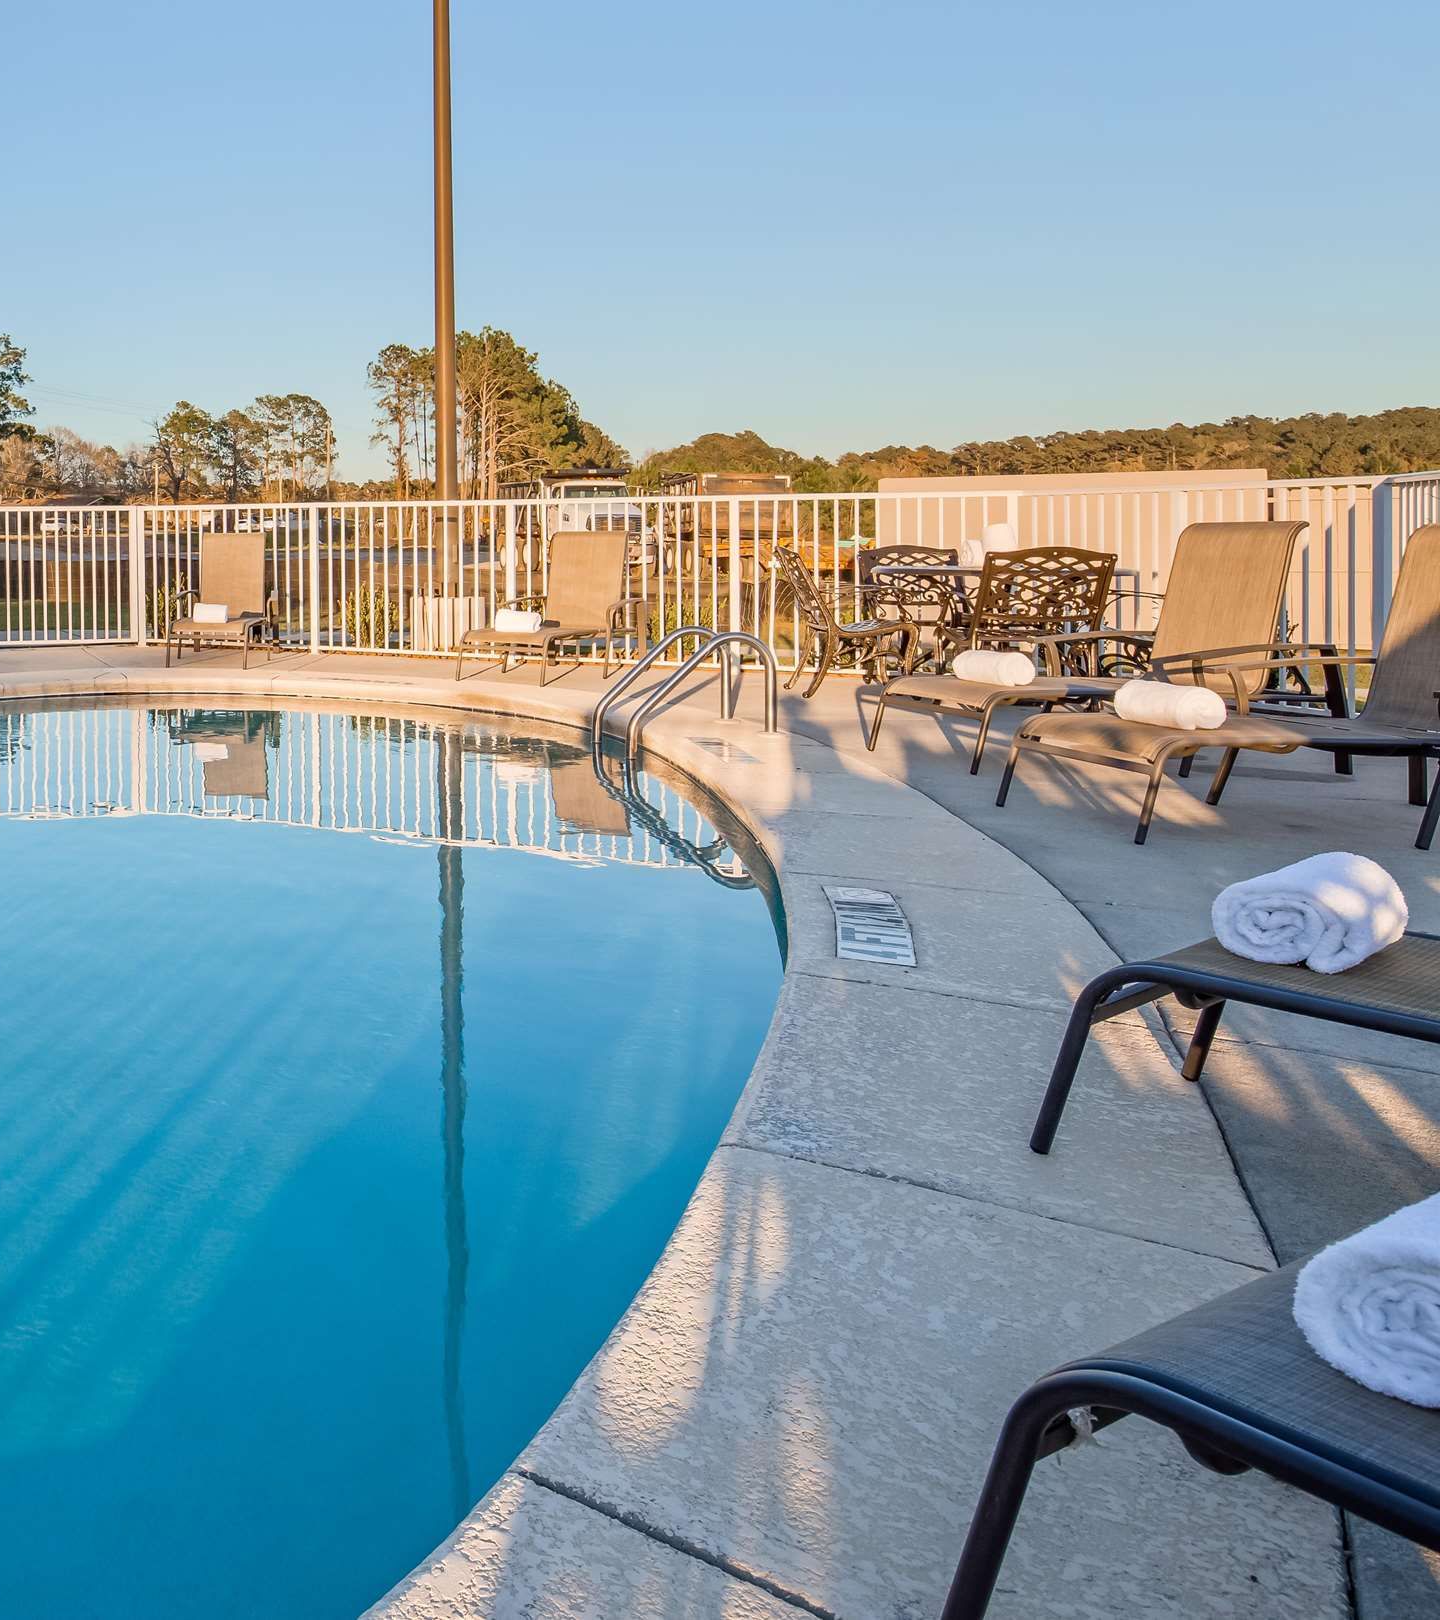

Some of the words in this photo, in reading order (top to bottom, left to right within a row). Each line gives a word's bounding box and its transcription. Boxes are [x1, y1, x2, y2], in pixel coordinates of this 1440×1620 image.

[834, 900, 899, 915] M
[840, 926, 909, 948] FT
[840, 947, 910, 959] 4
